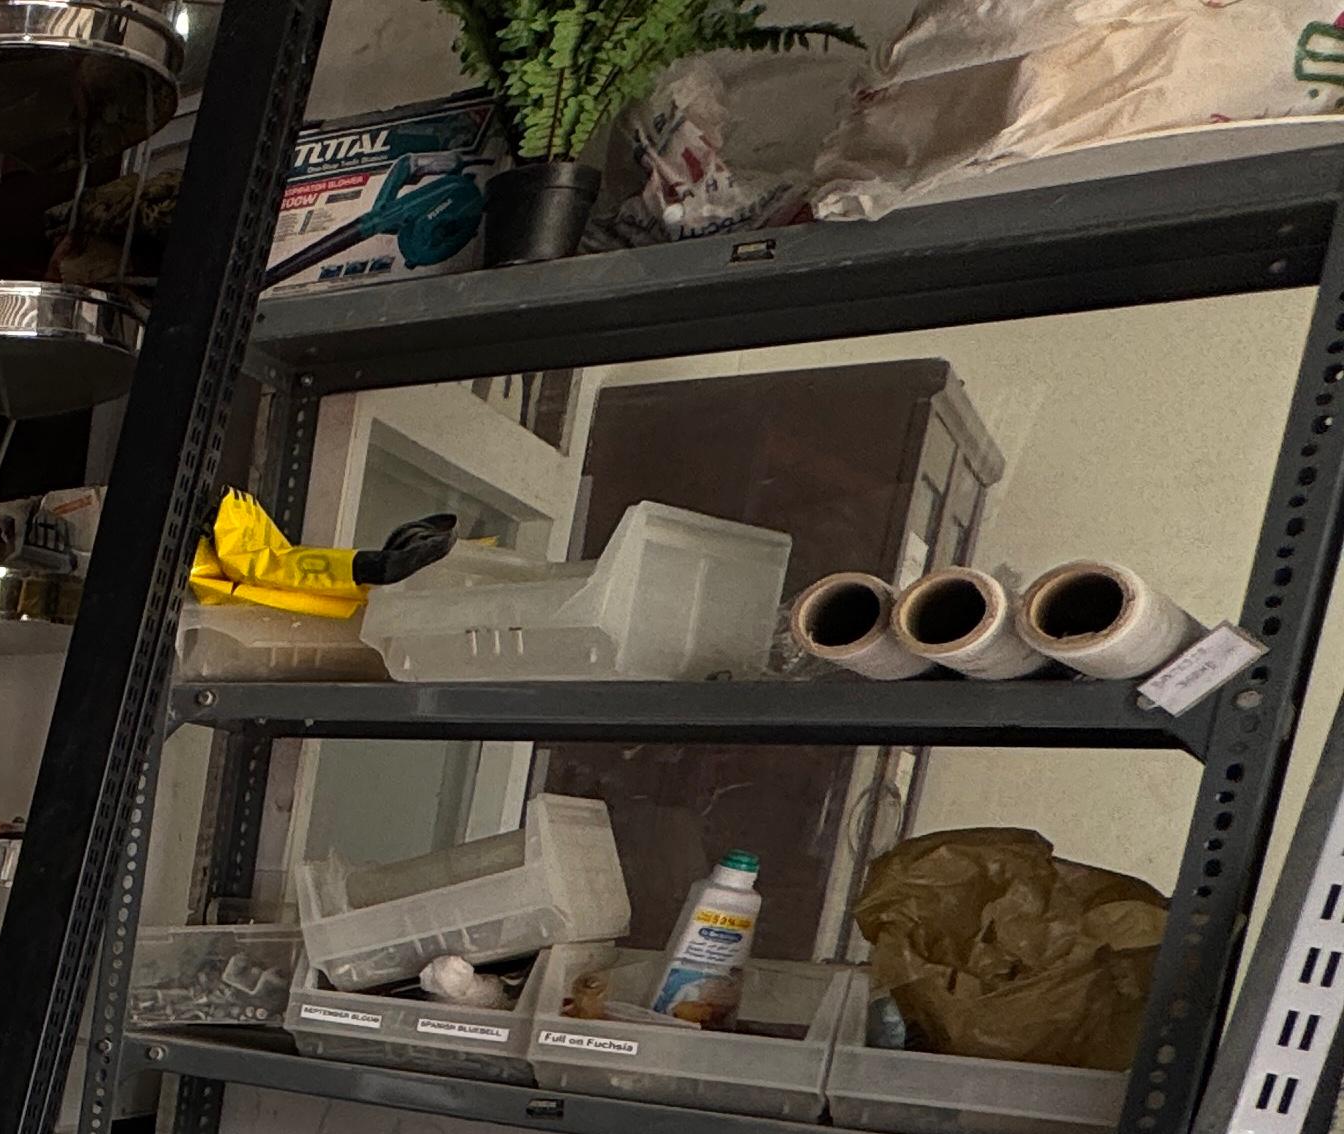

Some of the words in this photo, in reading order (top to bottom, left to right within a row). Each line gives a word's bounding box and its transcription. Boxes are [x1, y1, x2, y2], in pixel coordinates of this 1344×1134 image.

[294, 129, 391, 167] TOTAL
[544, 1032, 566, 1044] Full
[568, 1038, 584, 1046] on
[586, 1038, 634, 1052] Fuchsia
